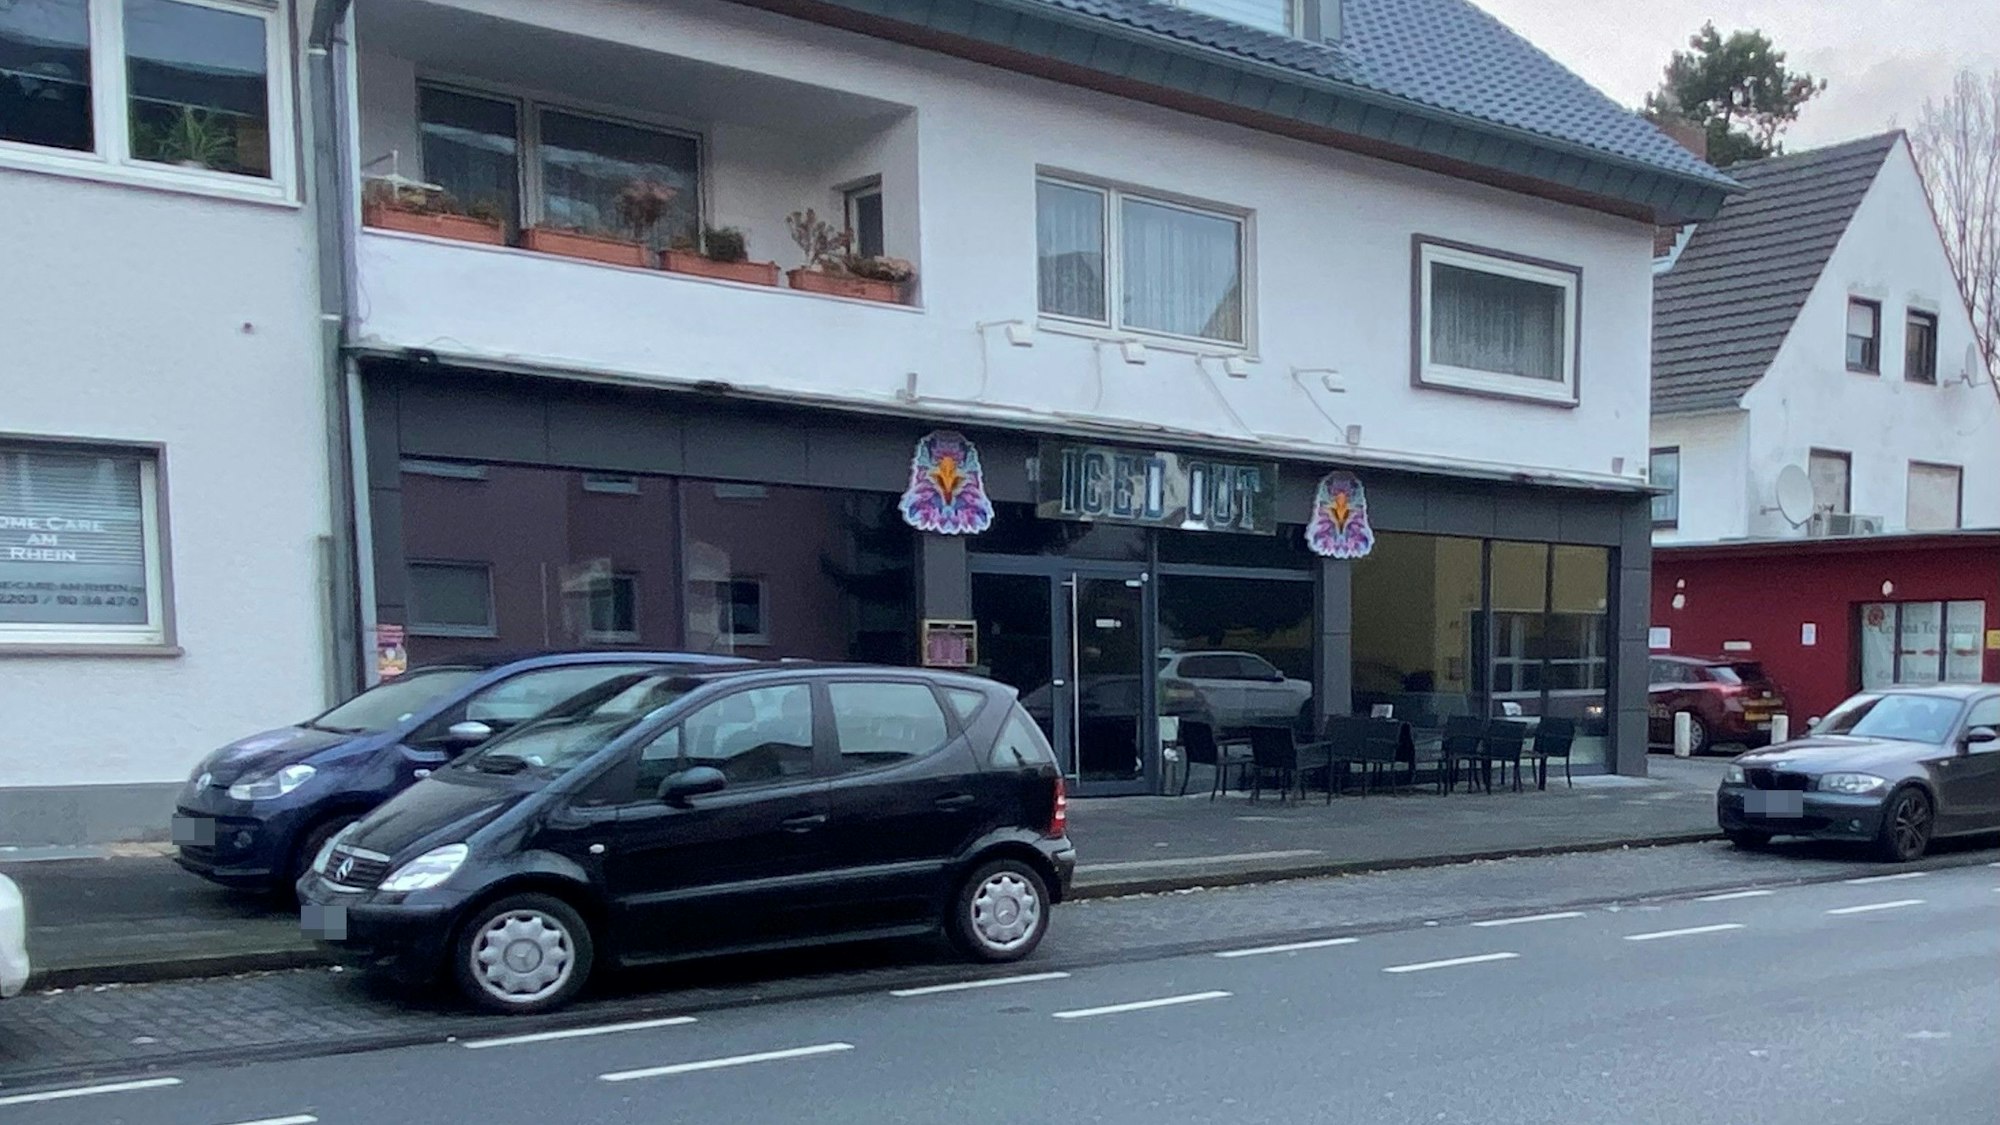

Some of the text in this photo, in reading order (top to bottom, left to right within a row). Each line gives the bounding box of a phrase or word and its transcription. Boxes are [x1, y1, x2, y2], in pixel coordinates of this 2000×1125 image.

[1060, 449, 1260, 529] ICED OUT
[0, 516, 39, 529] OME
